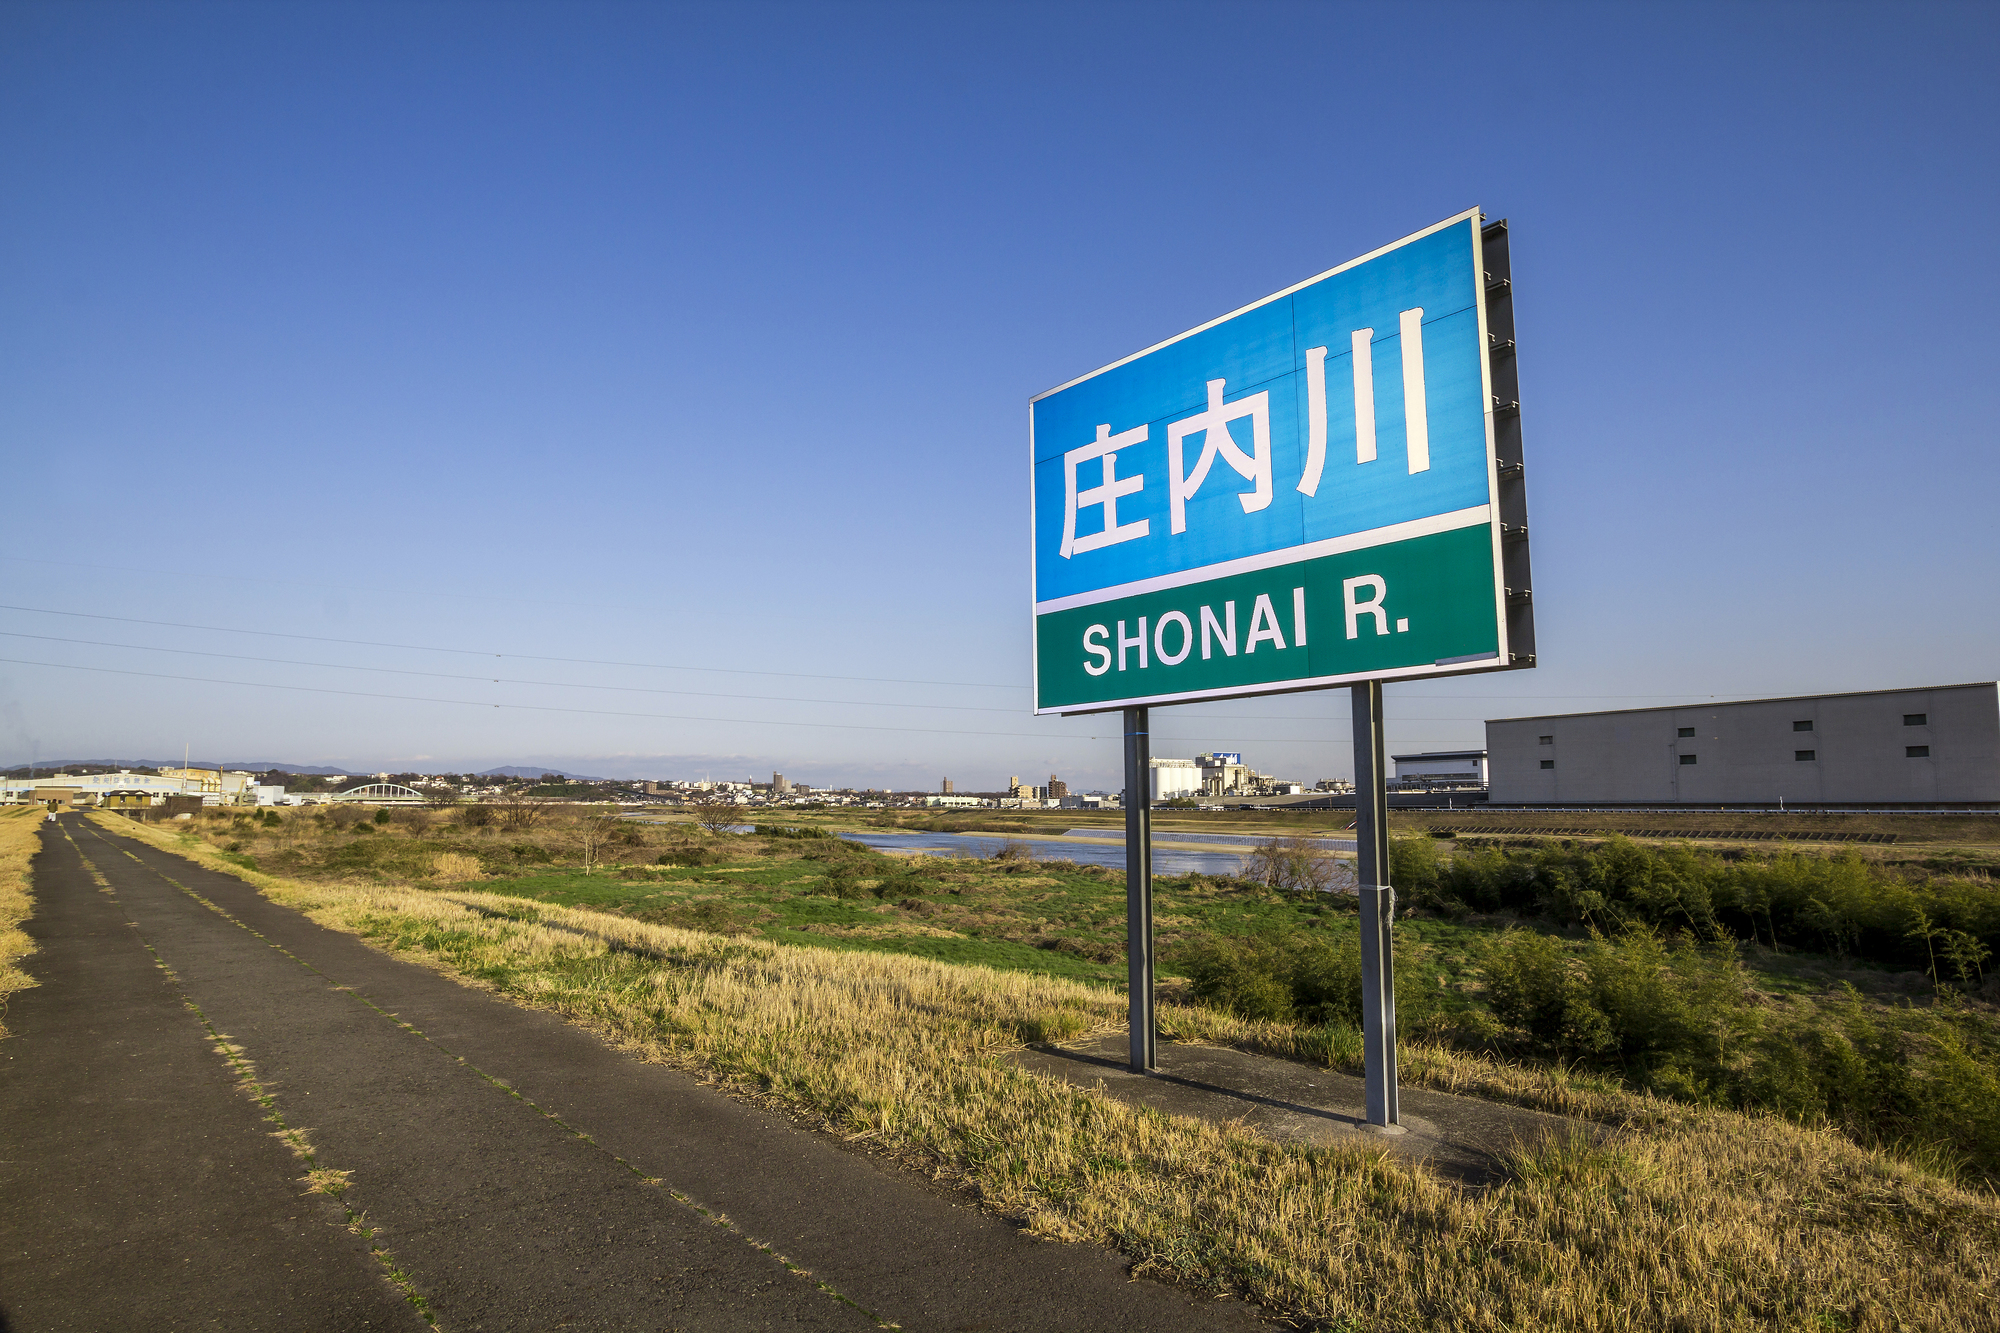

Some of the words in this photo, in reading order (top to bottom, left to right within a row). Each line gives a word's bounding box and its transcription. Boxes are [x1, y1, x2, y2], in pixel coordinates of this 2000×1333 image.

[1060, 307, 1430, 560] 庄内川
[1083, 586, 1308, 677] SHONAI
[1343, 574, 1410, 640] R.
